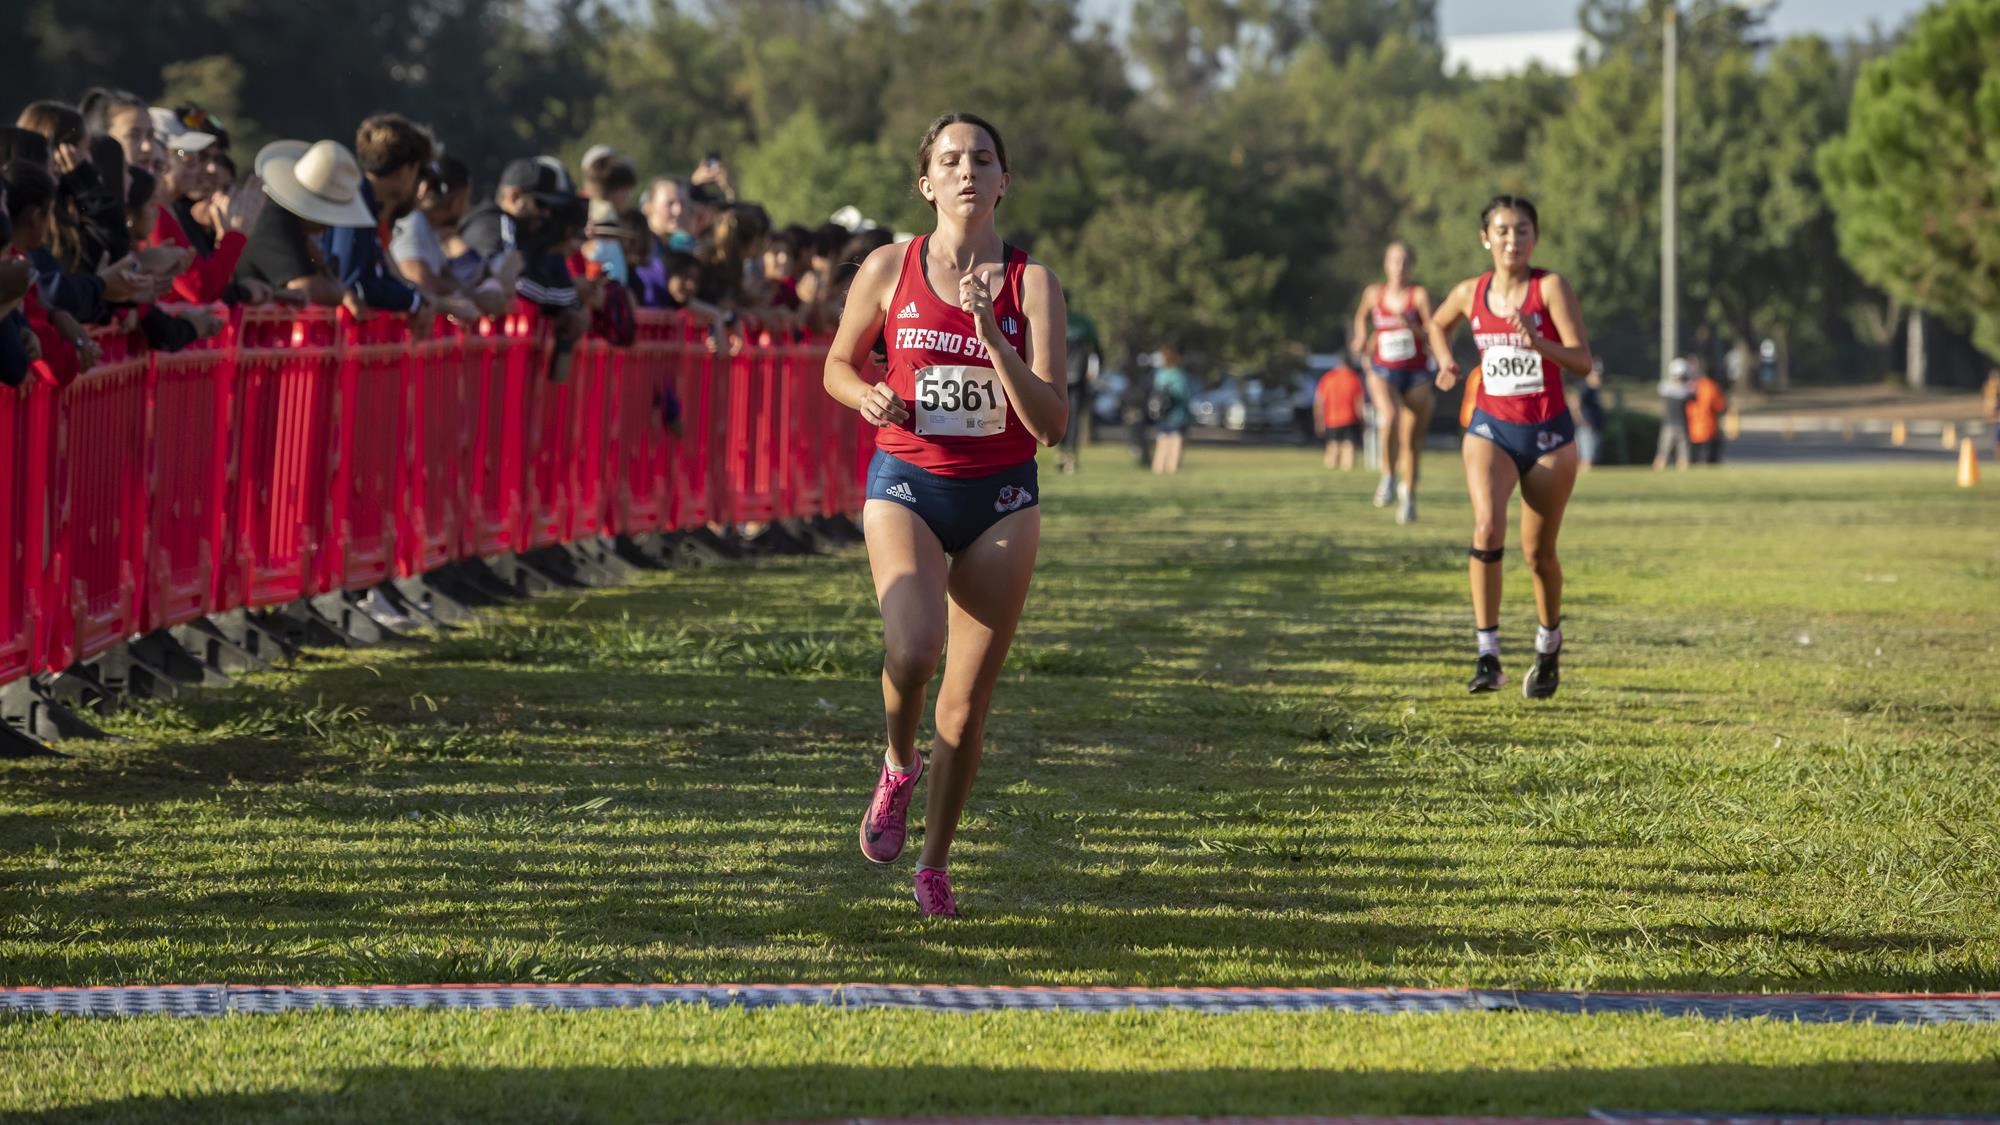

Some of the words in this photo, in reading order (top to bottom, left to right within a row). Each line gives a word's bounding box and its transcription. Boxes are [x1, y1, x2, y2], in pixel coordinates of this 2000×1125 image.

[895, 328, 962, 353] FRESNO
[1487, 357, 1537, 377] 5362
[921, 380, 996, 411] 5361
[886, 488, 917, 503] adidas
